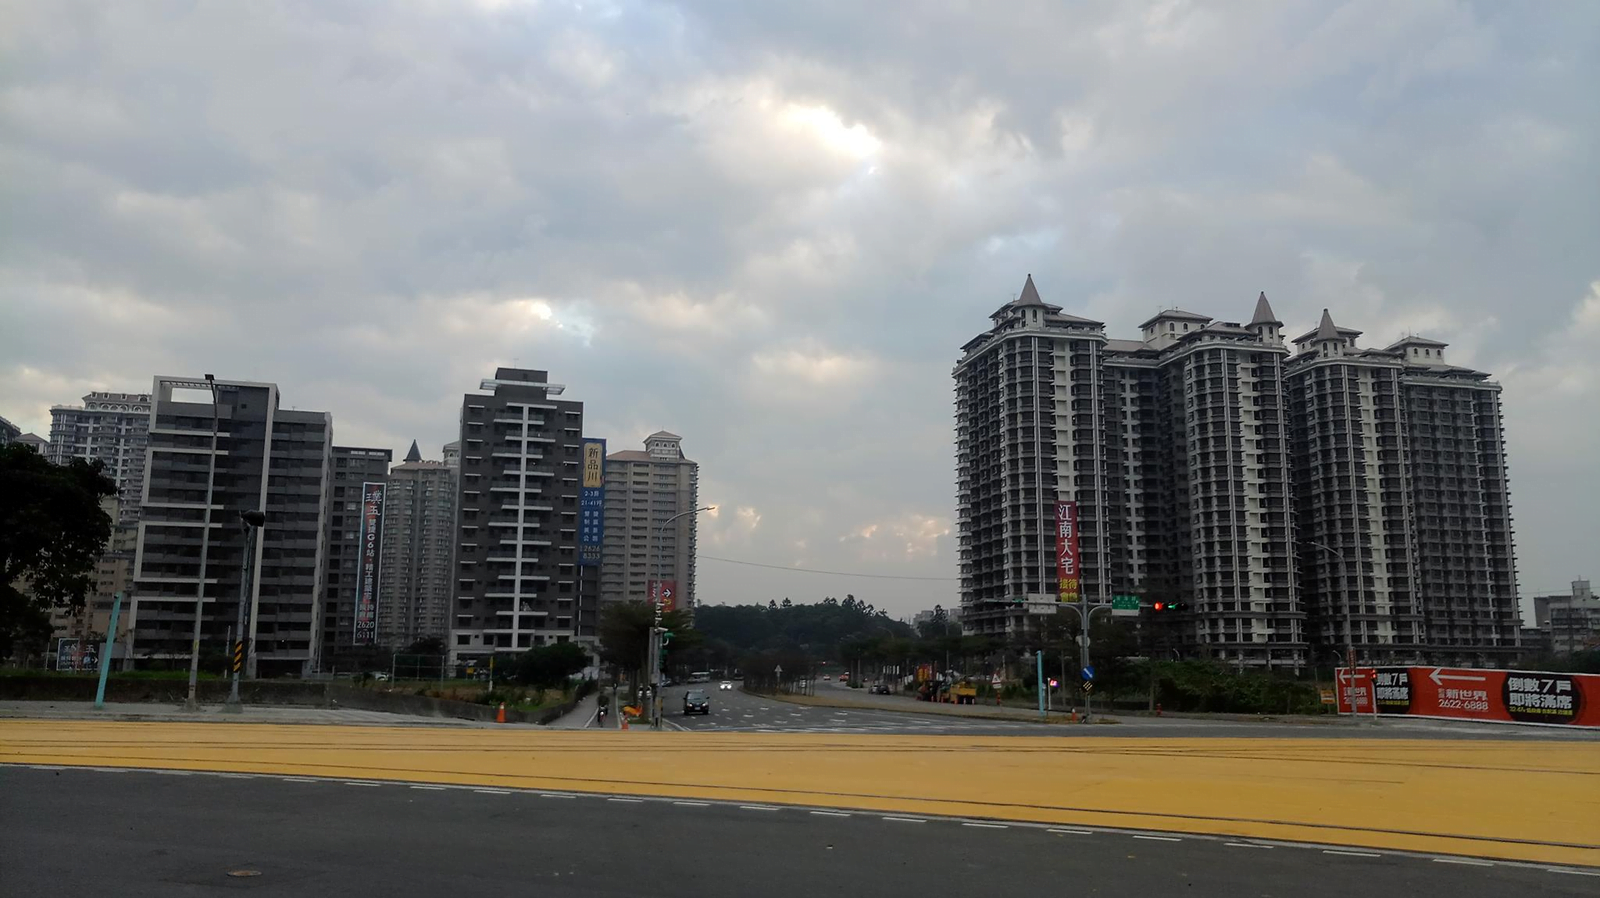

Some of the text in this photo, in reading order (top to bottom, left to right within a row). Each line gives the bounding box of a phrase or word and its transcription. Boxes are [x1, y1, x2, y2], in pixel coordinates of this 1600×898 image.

[586, 447, 598, 482] 新品川
[1058, 503, 1074, 575] 江南大宅
[1059, 577, 1077, 590] 接待
[357, 620, 375, 629] 2620
[1507, 676, 1572, 693] 倒數7戶
[1445, 688, 1488, 701] 新世界
[1509, 692, 1573, 710] 即將滿席
[1438, 698, 1489, 710] 2622-6888
